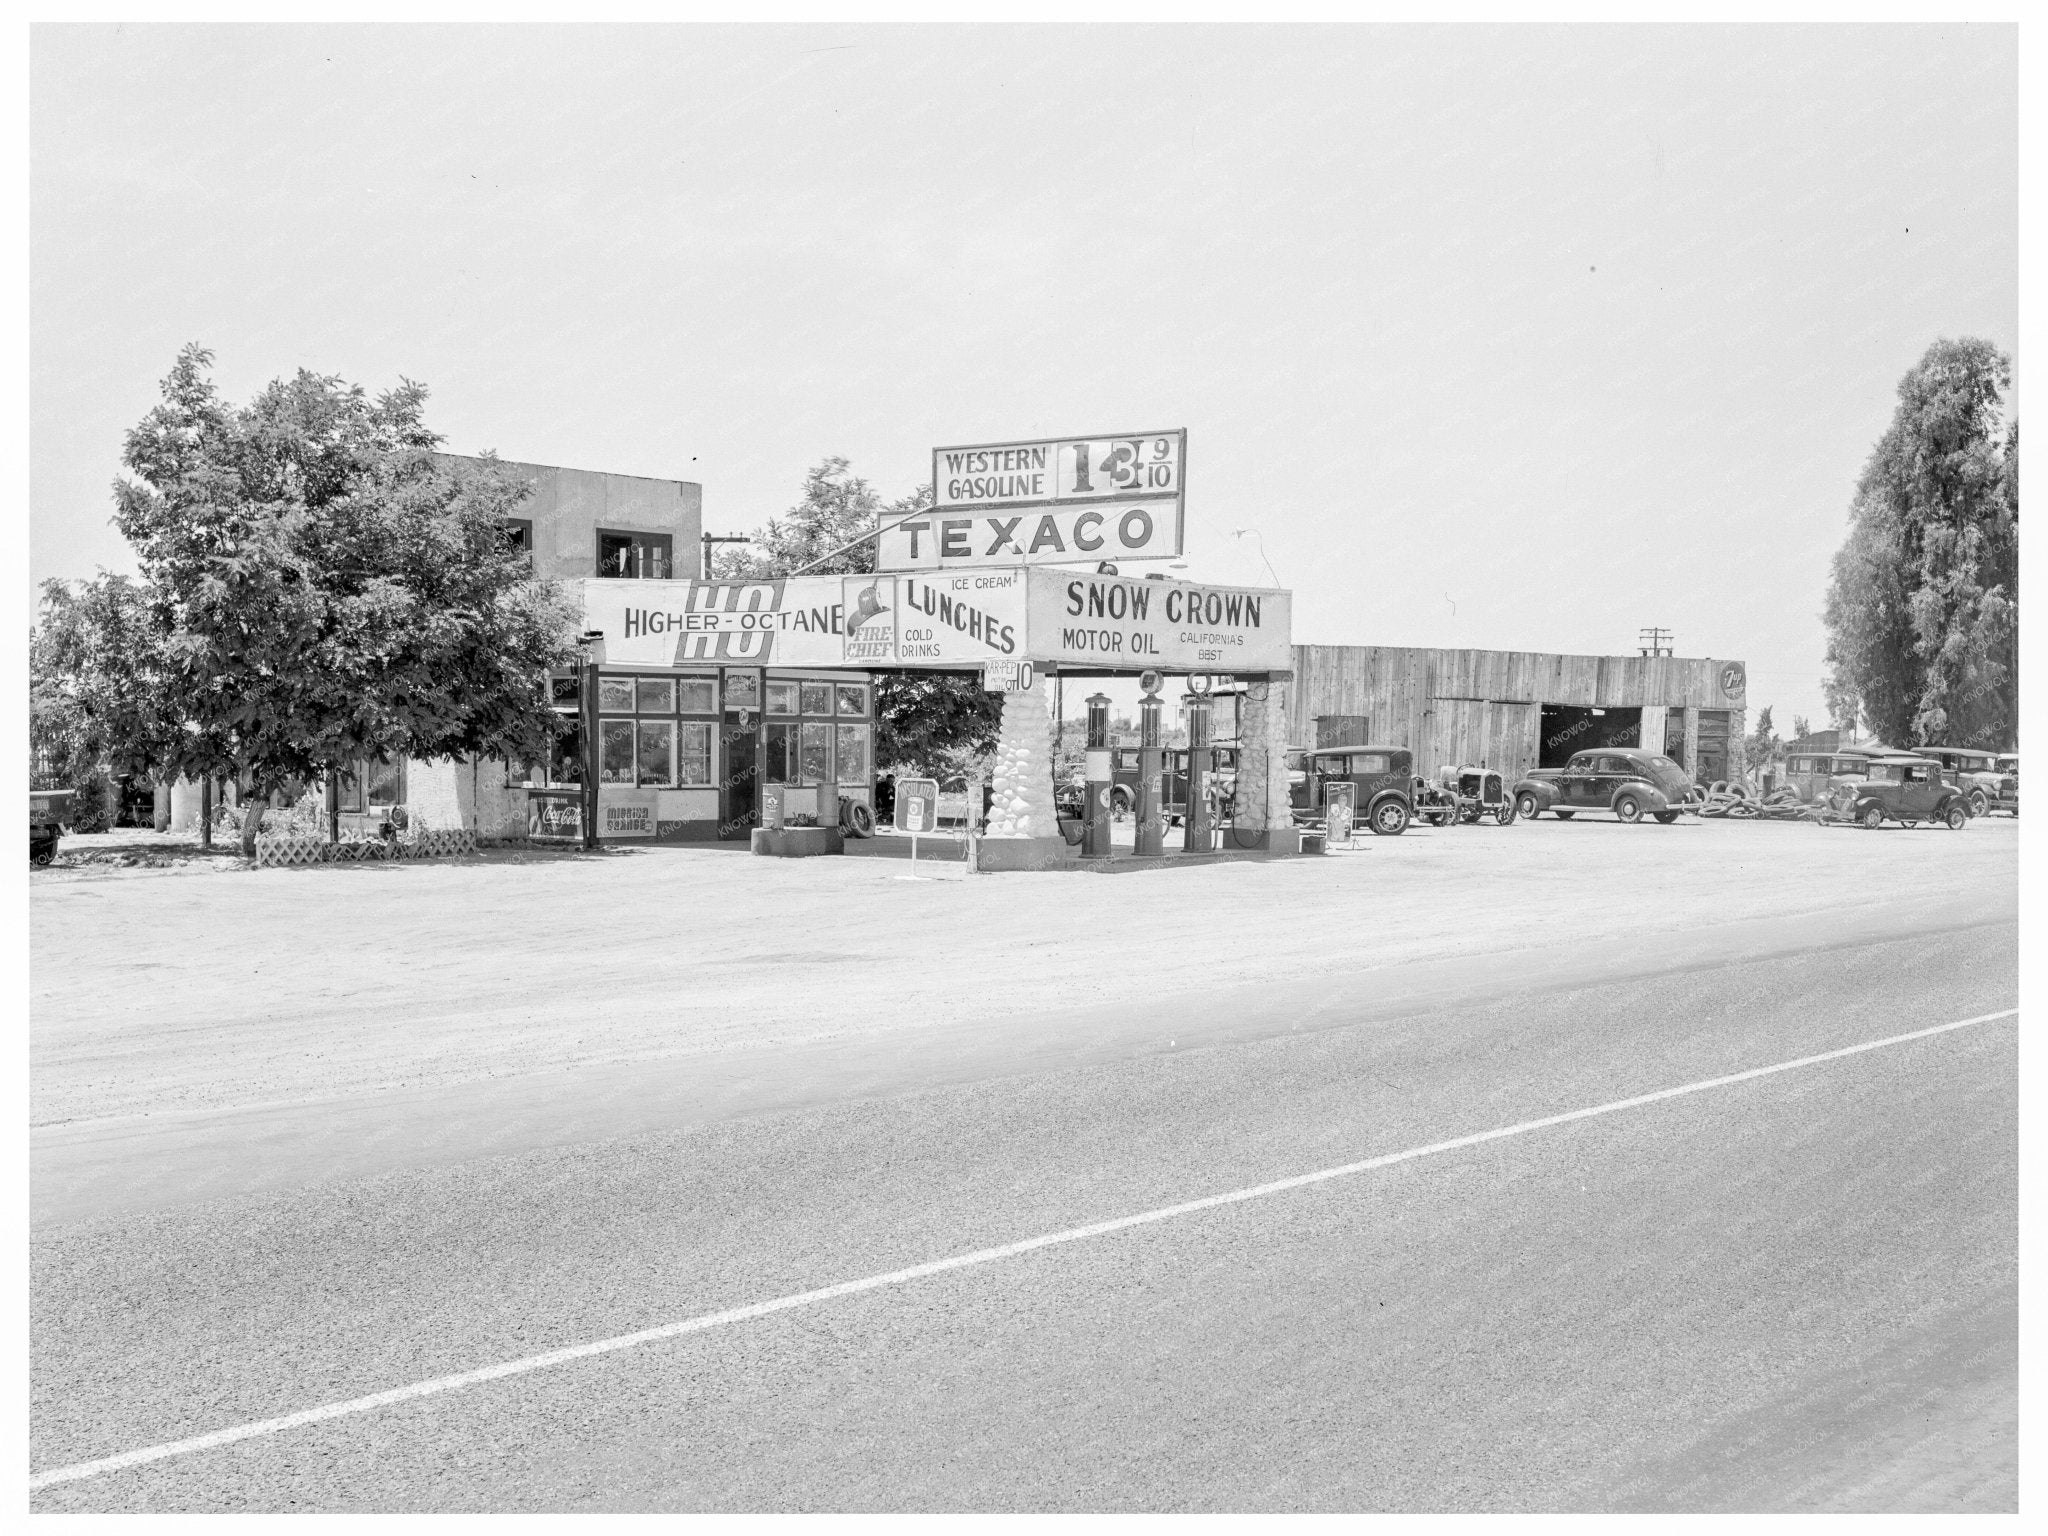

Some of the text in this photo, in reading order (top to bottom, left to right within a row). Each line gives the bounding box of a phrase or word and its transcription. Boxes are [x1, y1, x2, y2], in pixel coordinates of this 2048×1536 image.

[946, 447, 1046, 474] WESTERN
[948, 473, 1044, 500] GASOLINE
[899, 509, 1154, 558] TEXACO
[952, 577, 1012, 590] ICE CREAM
[908, 579, 1015, 654] LUNCHES
[1066, 580, 1261, 628] SNOW CROWN
[905, 629, 933, 641] COLD
[1063, 628, 1160, 654] MOTOR OIL
[1180, 632, 1244, 646] CALIFORNIA'S
[847, 642, 893, 658] CHIEF
[902, 643, 940, 657] DRINKS
[1198, 649, 1223, 661] BEST
[1016, 662, 1033, 690] 10
